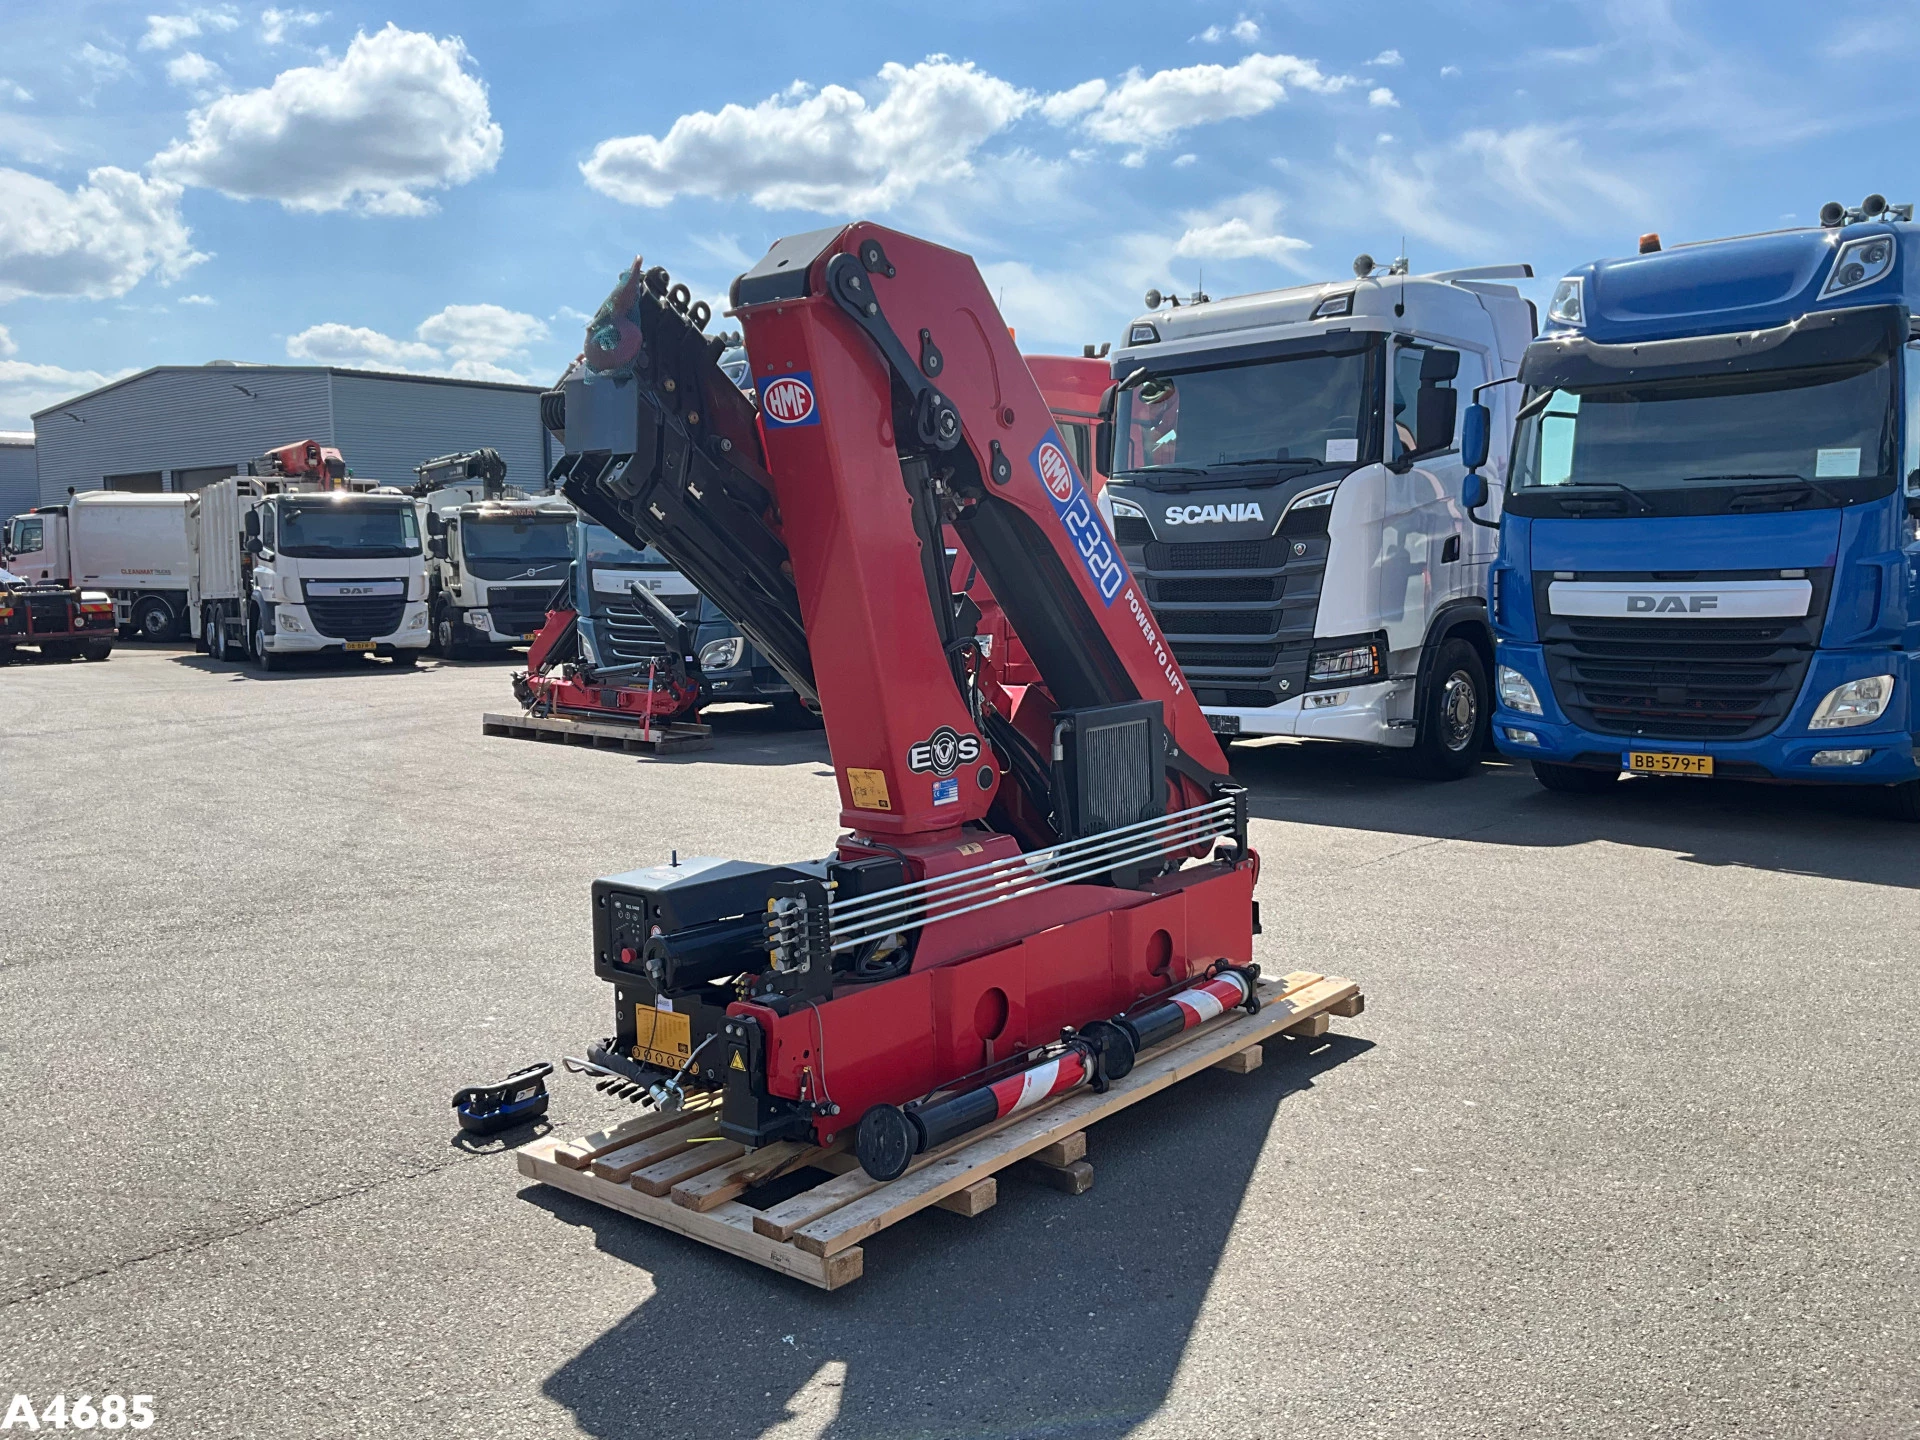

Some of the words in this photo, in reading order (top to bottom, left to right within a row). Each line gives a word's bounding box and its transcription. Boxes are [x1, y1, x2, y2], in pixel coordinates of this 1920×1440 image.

[769, 384, 806, 418] HMF
[1042, 448, 1069, 493] HMF
[1165, 502, 1264, 525] SCANIA
[1065, 498, 1123, 598] 2320
[340, 587, 374, 595] DAF
[1626, 595, 1718, 613] DAF
[1124, 587, 1156, 647] POWER
[1153, 641, 1168, 666] TO
[1164, 663, 1184, 695] LIFT
[1635, 754, 1706, 771] BB-579-F
